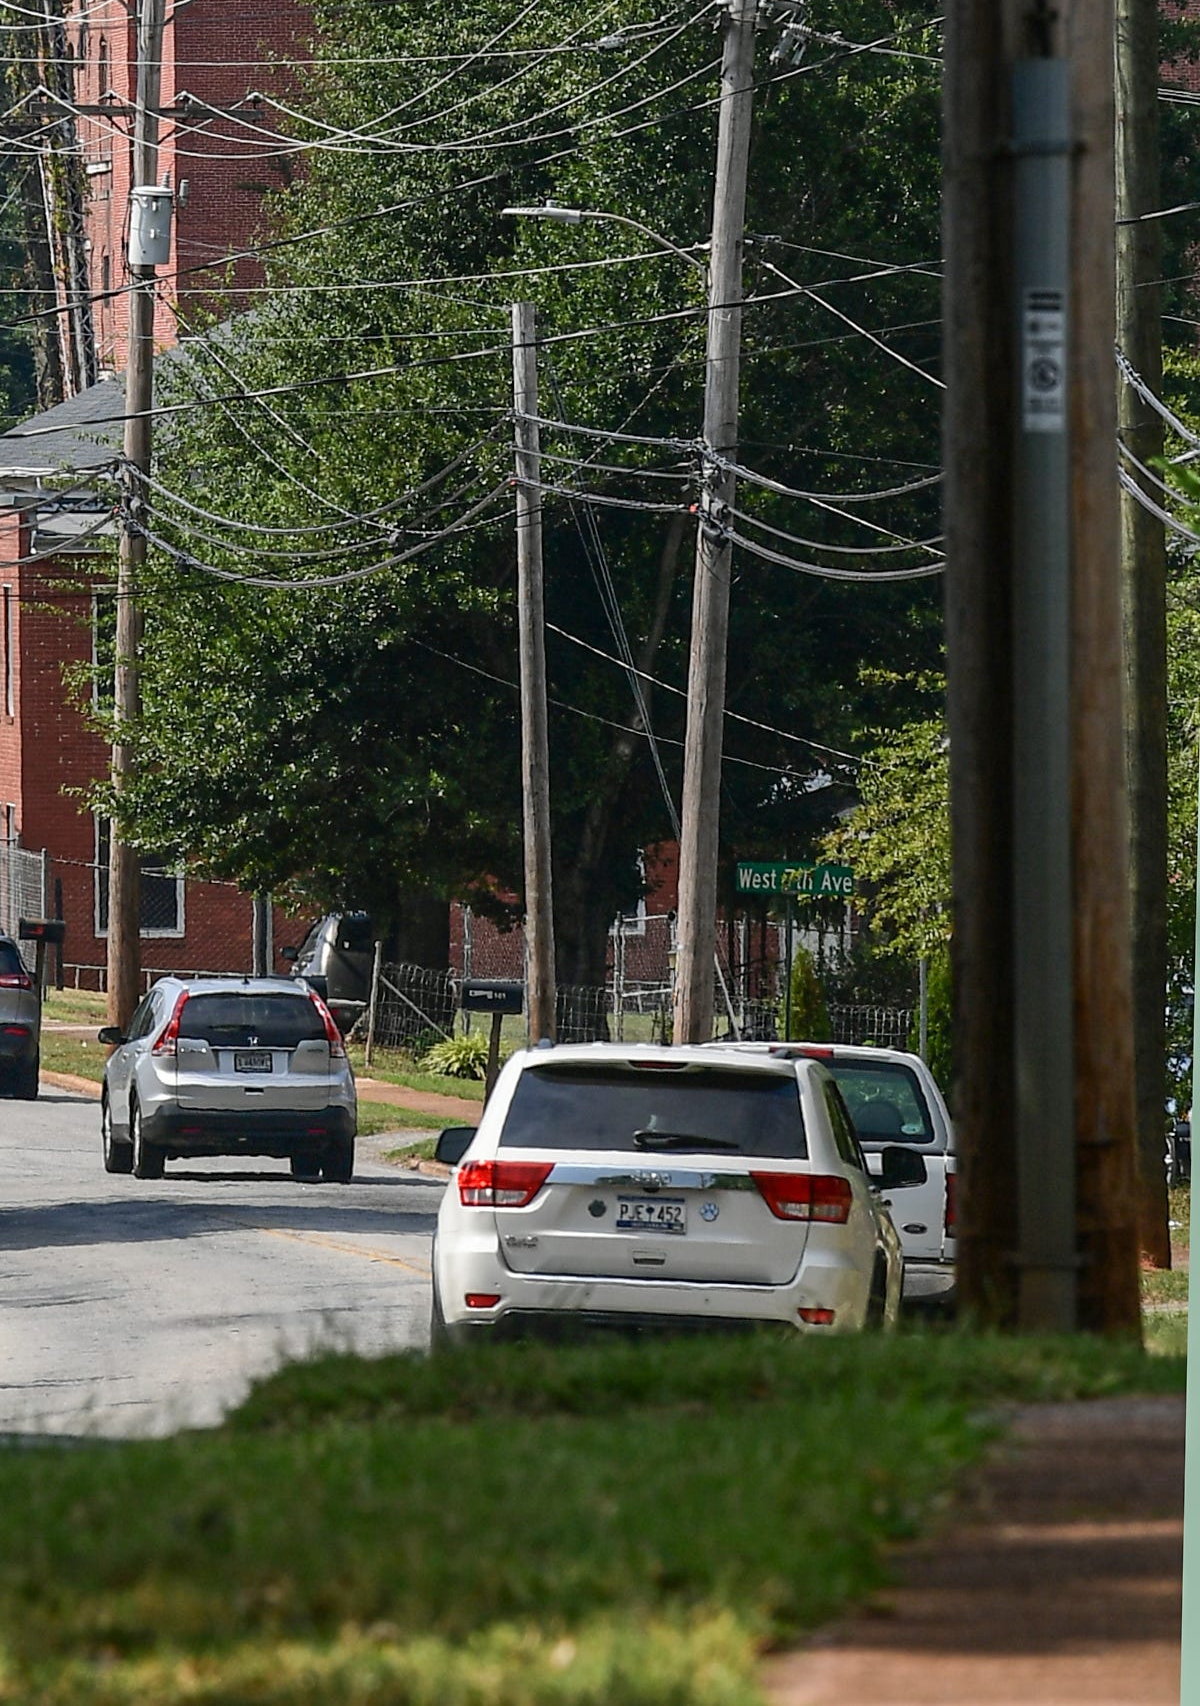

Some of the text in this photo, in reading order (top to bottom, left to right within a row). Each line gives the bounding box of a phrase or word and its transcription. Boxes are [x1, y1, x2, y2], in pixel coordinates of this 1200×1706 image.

[739, 868, 777, 890] West
[821, 871, 853, 892] Ave
[657, 1206, 682, 1223] 452
